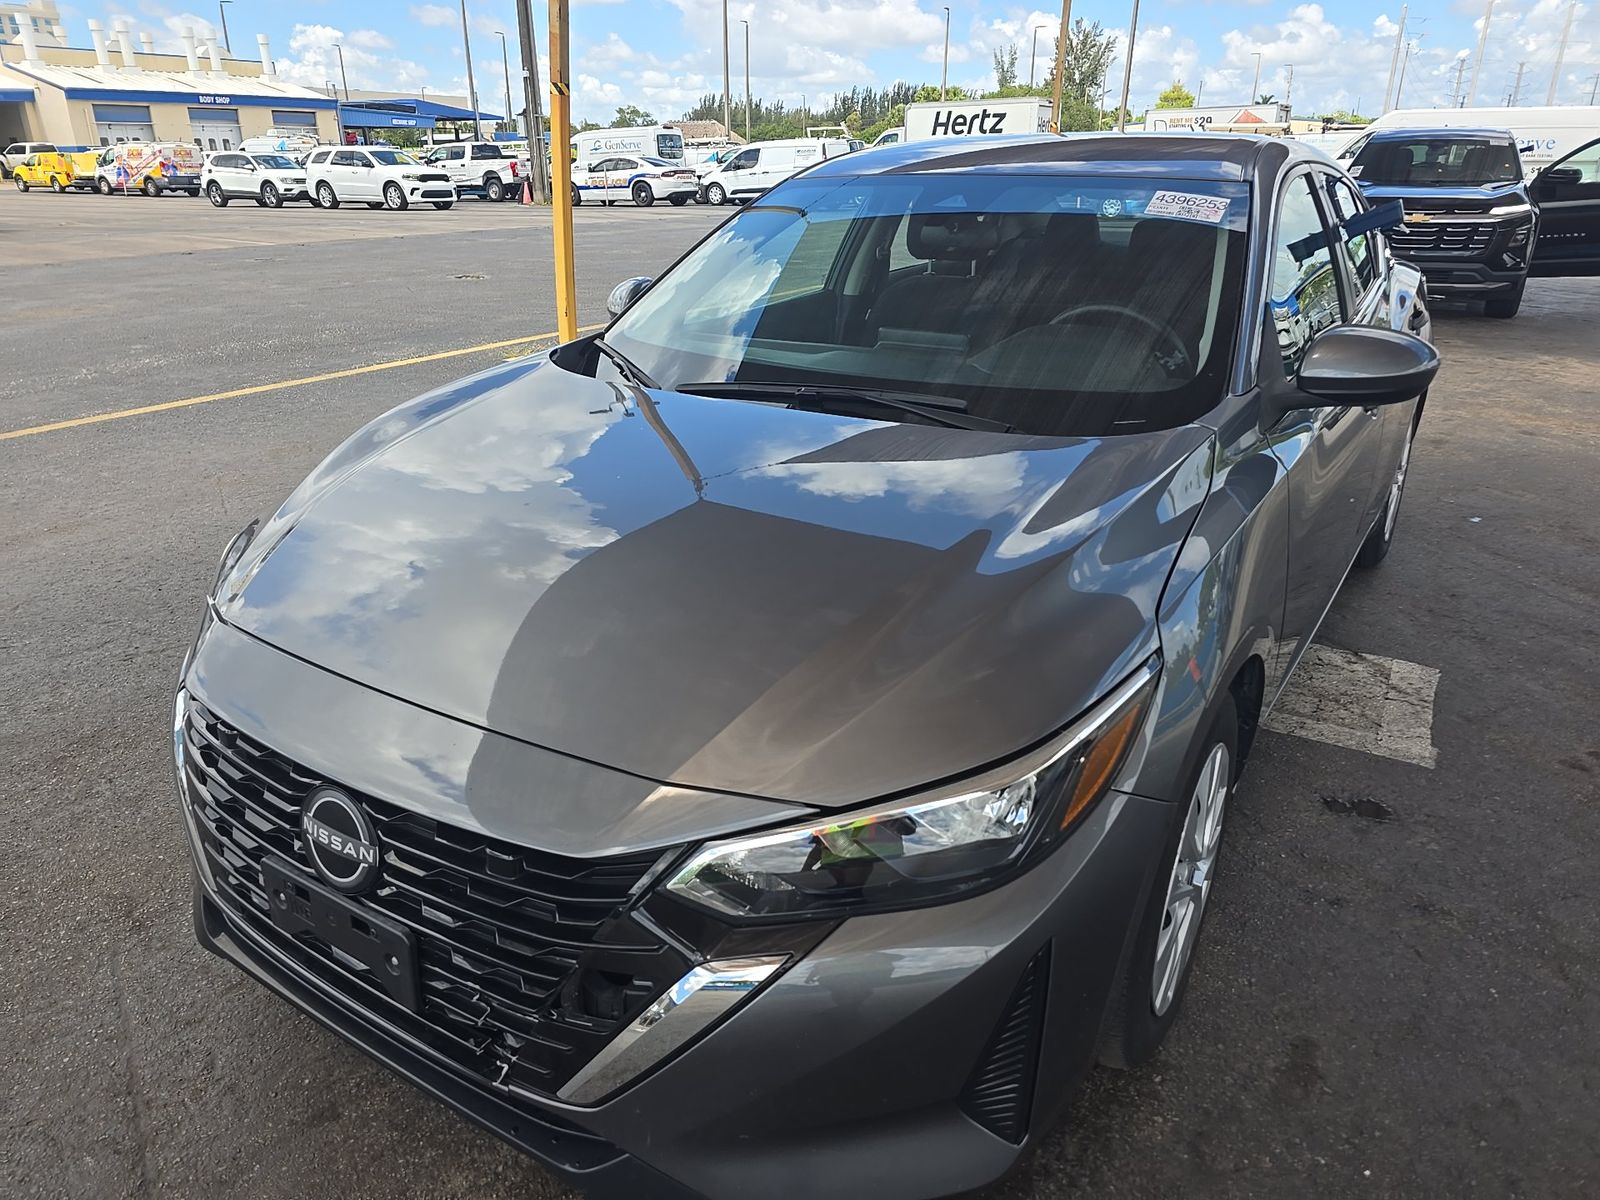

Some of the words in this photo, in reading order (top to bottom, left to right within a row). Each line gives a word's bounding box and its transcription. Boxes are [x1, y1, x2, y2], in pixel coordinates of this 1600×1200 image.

[199, 95, 214, 103] BODY
[215, 96, 231, 104] SHOP
[931, 109, 1007, 136] Hertz
[604, 140, 642, 151] GenServe
[590, 178, 628, 187] POLICE
[1155, 193, 1228, 211] 4396253
[303, 815, 374, 863] NISSAN
